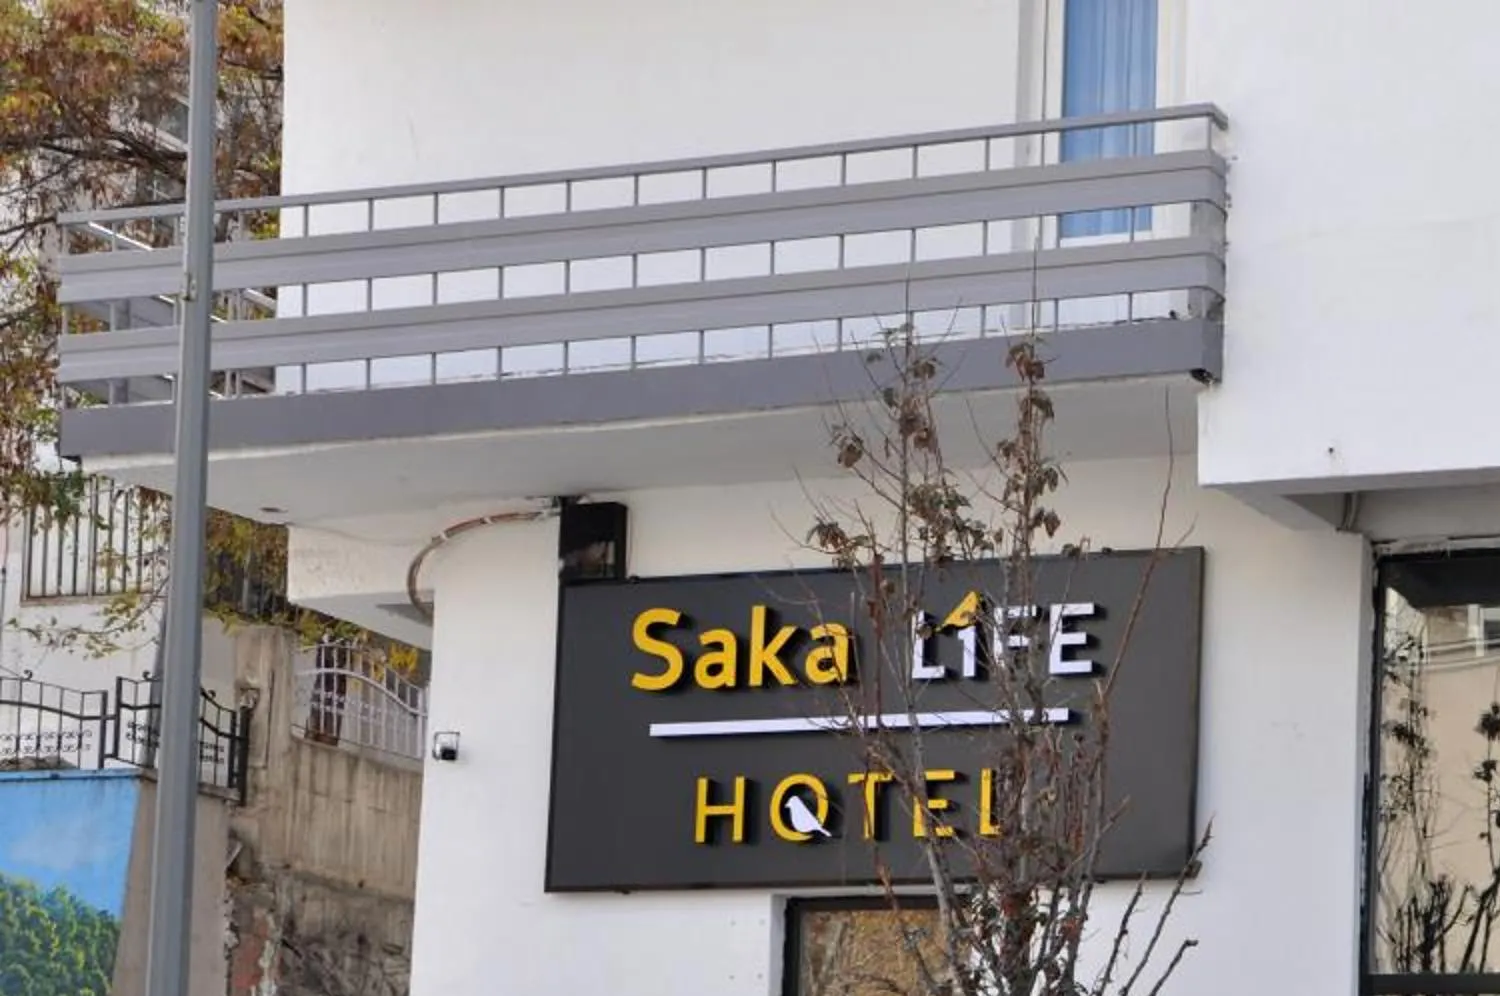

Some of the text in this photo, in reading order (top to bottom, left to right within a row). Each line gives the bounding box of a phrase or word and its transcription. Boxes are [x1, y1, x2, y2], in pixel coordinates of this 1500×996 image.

[630, 594, 1097, 691] Saka LIFE
[694, 768, 1003, 843] HOTEL
